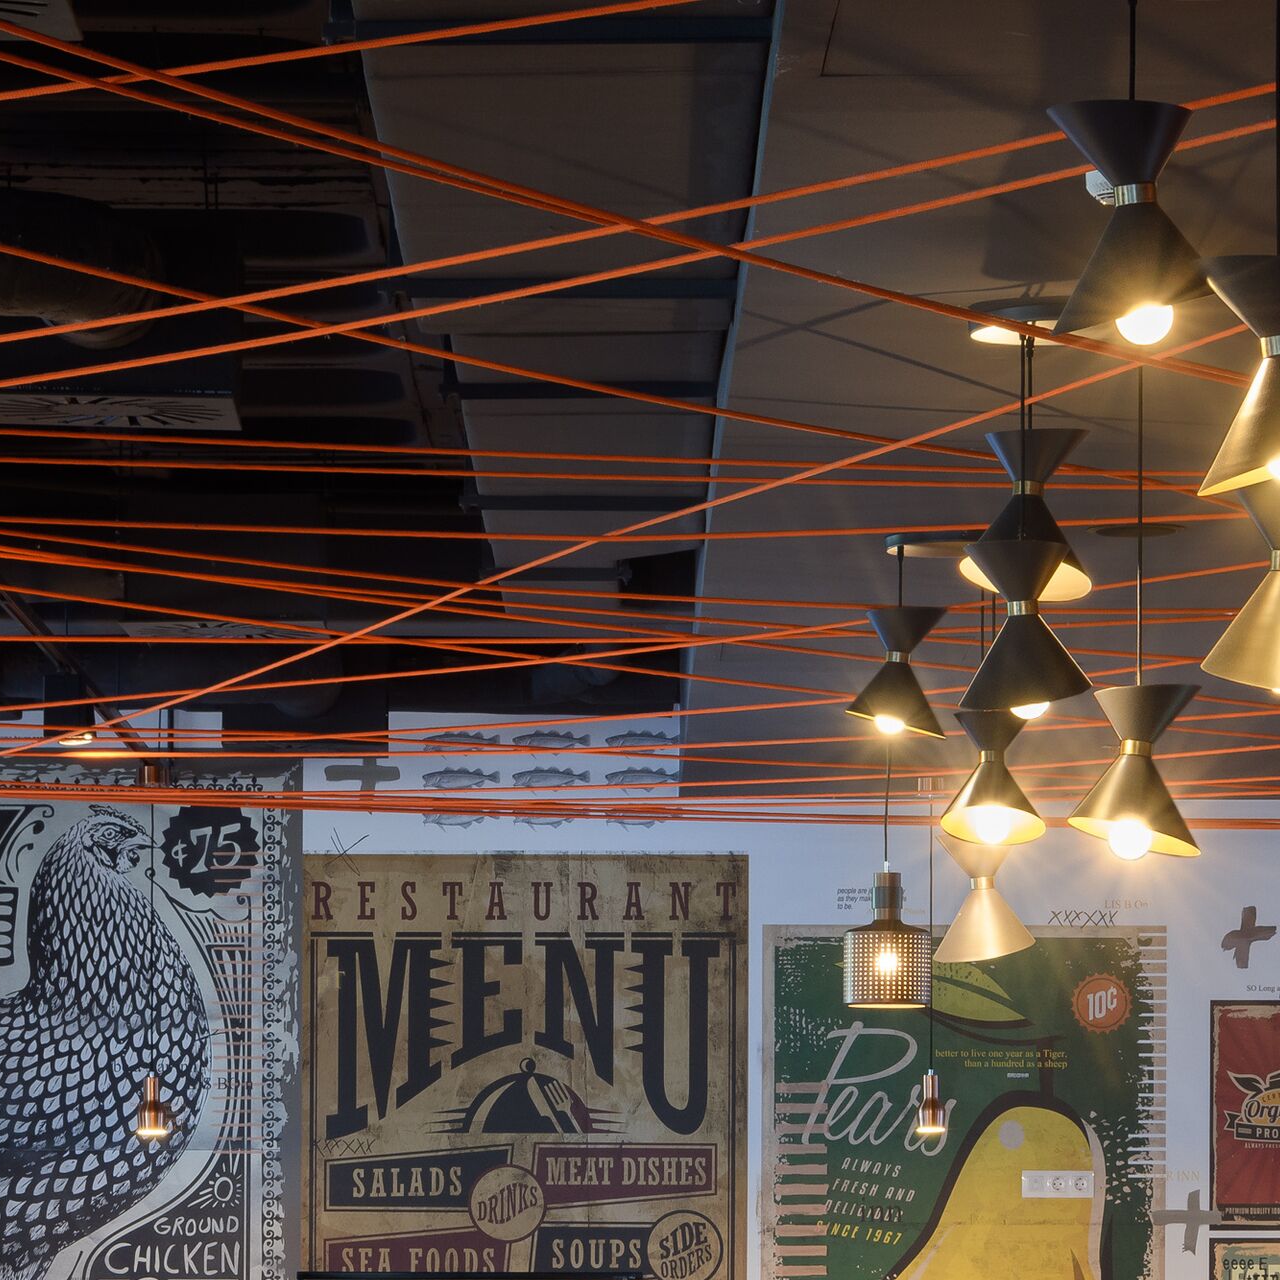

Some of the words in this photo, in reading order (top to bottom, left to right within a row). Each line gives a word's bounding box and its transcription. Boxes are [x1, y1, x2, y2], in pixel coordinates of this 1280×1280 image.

[311, 881, 737, 920] RESTAURANT
[837, 888, 857, 896] people
[845, 896, 858, 904] they
[1259, 985, 1275, 993] Long
[326, 939, 720, 1139] MENU
[935, 1049, 959, 1057] better
[961, 1049, 969, 1057] to
[971, 1049, 986, 1057] live
[1005, 1051, 1023, 1059] year
[965, 1060, 982, 1068] than
[991, 1060, 1024, 1068] hundred
[1044, 1060, 1068, 1069] sheep
[546, 1156, 614, 1187] MEAT
[623, 1156, 707, 1187] DISHES
[841, 1157, 902, 1178] ALWAYS
[352, 1167, 463, 1198] SALADS
[832, 1178, 879, 1197] FRESH
[885, 1186, 916, 1202] AND
[476, 1183, 539, 1225] DRINKS
[1225, 1207, 1249, 1215] PREMIUM
[1250, 1207, 1271, 1215] QUALITY
[154, 1215, 239, 1237] GROUND
[866, 1228, 902, 1245] 1967
[659, 1221, 708, 1260] SIDE
[104, 1241, 240, 1277] CHICKEN
[341, 1247, 391, 1272] SEA
[409, 1247, 496, 1272] FOODS
[552, 1239, 641, 1269] SOUPS
[660, 1245, 713, 1280] ORDERS
